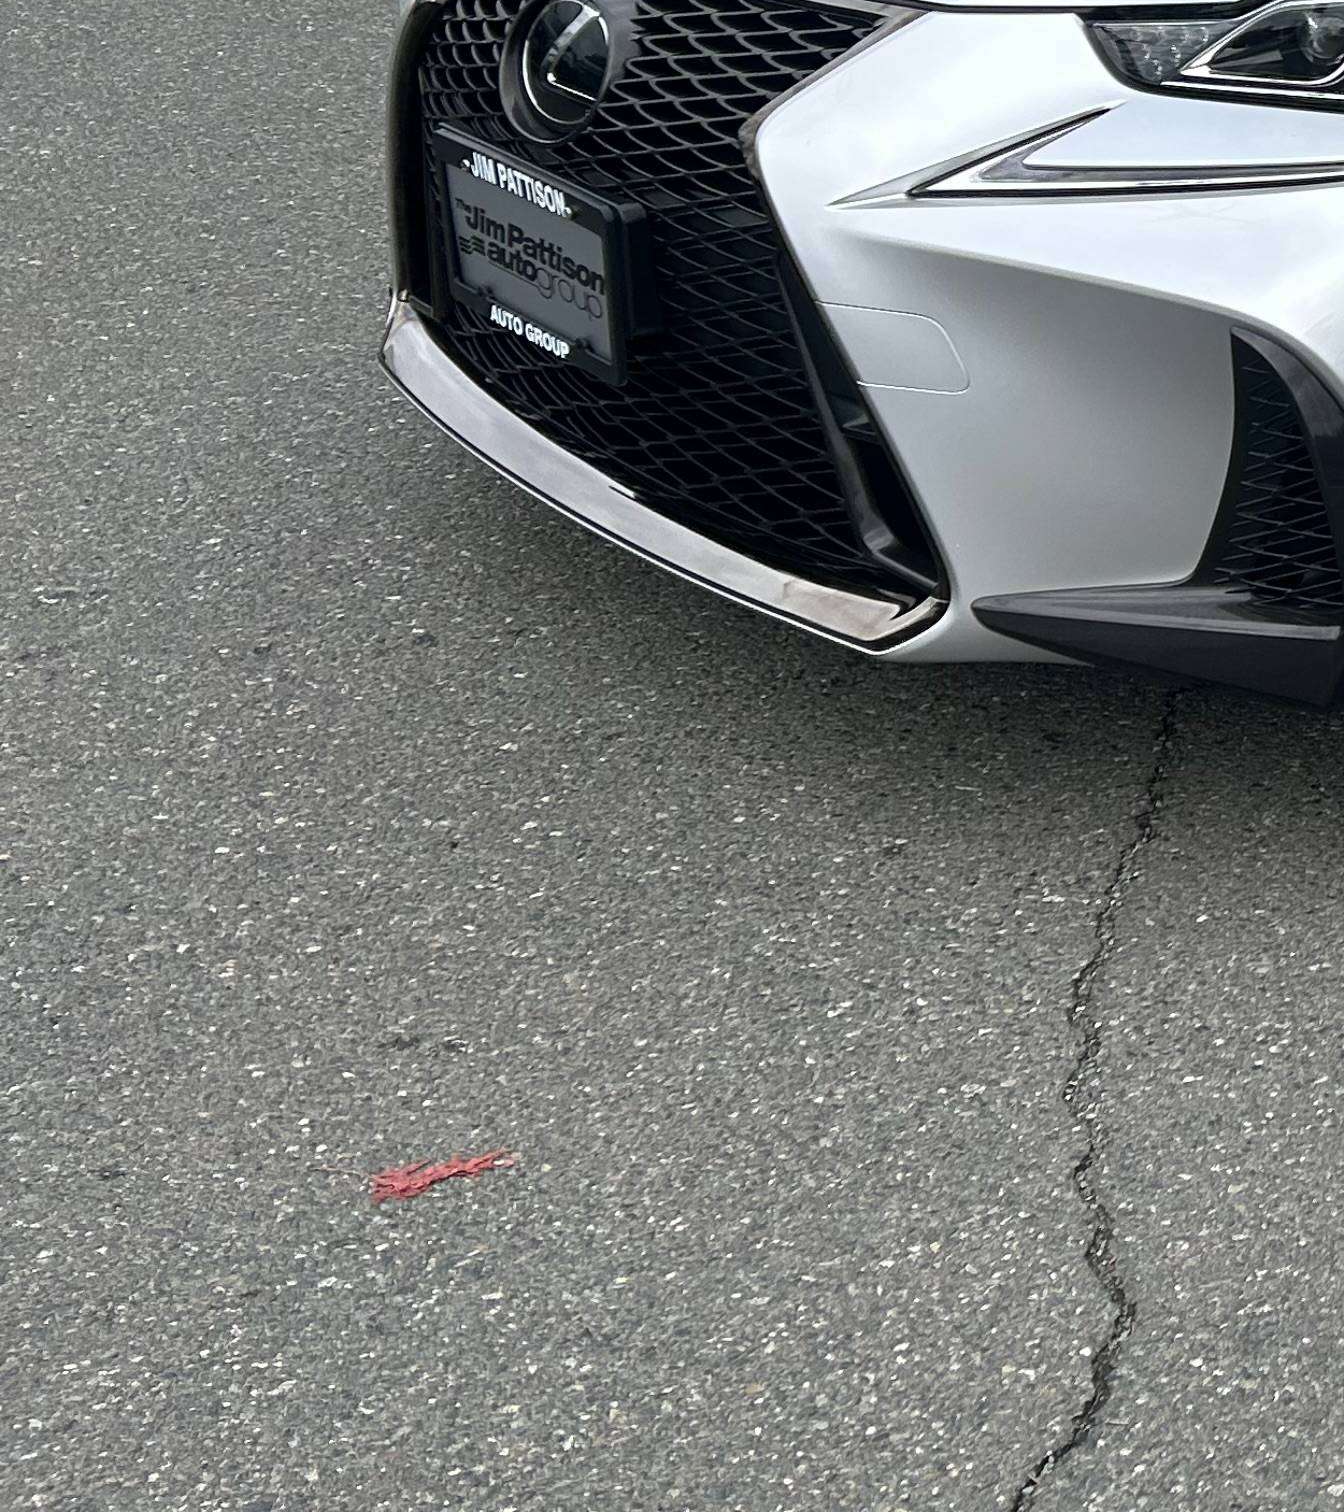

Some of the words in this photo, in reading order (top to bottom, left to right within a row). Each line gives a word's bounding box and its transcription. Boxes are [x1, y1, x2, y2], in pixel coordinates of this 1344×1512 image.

[470, 151, 497, 185] JIM
[497, 162, 568, 218] PATTISON
[490, 304, 523, 336] AUTO
[524, 323, 570, 359] GROUP
